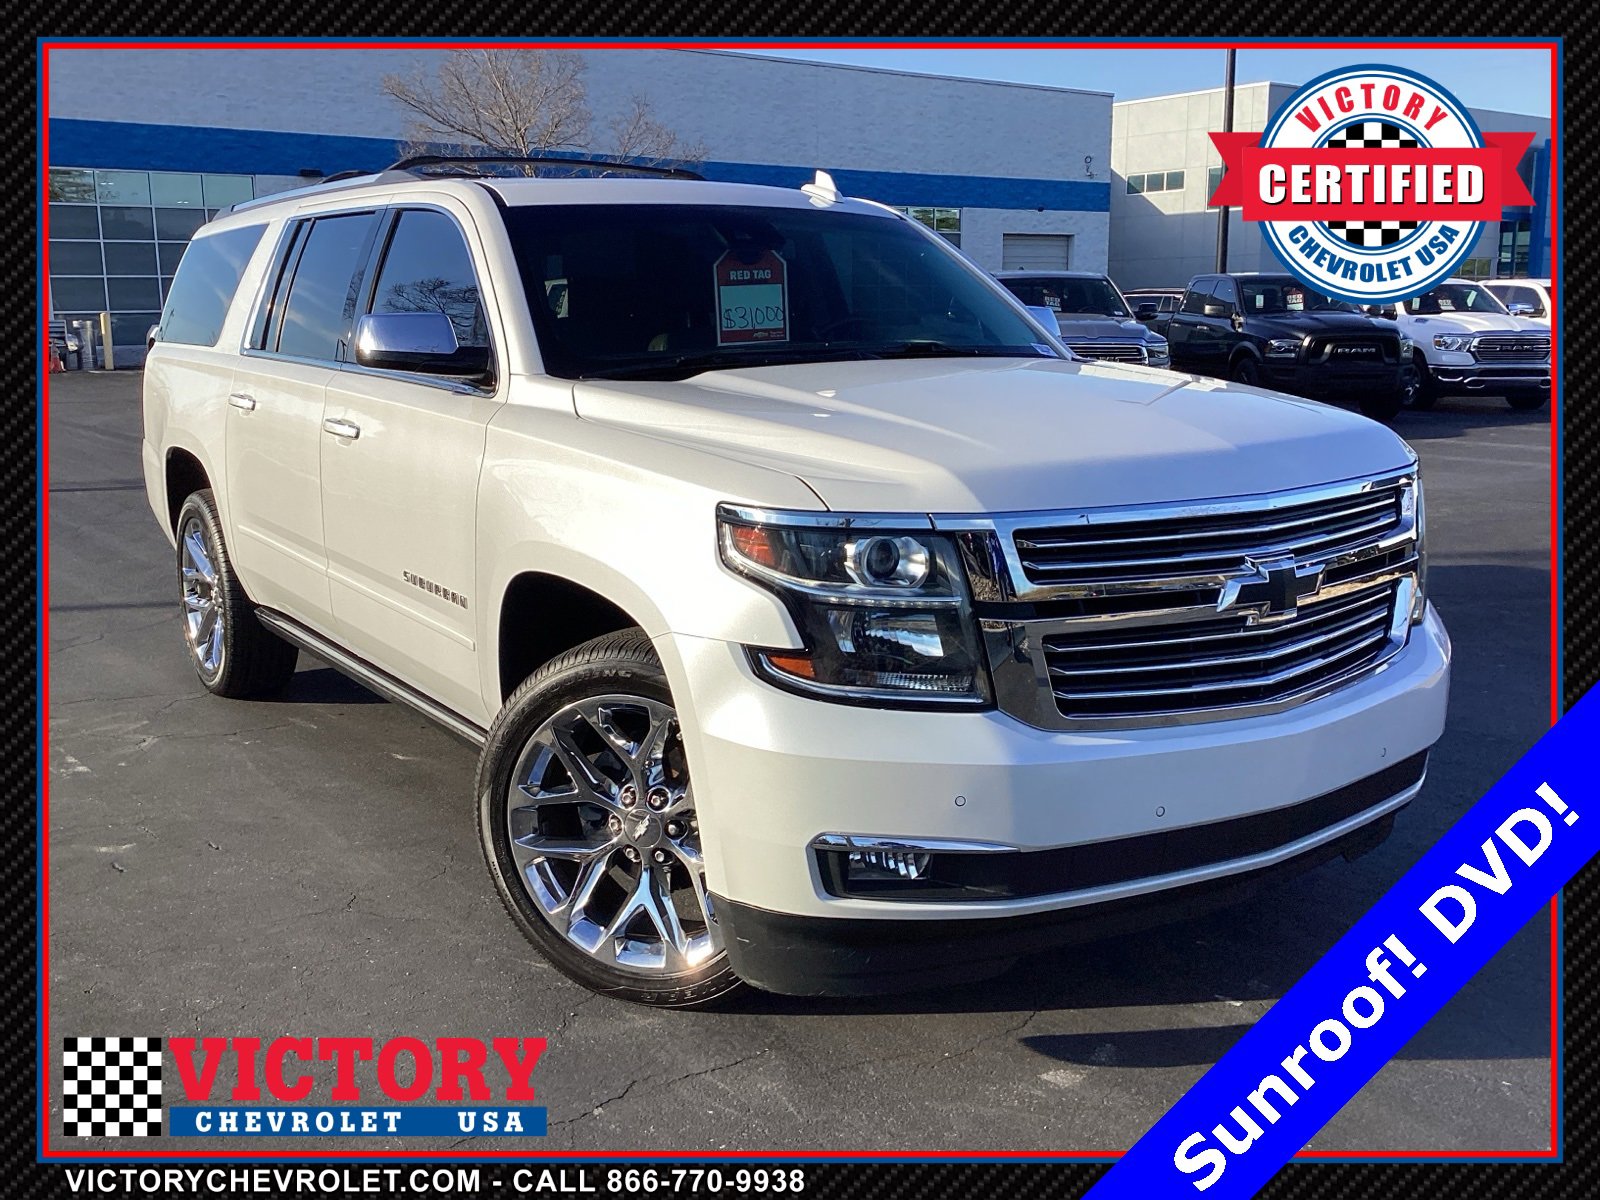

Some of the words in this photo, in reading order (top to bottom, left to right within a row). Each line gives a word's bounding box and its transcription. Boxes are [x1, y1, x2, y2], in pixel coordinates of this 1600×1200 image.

[730, 270, 751, 280] RED
[753, 269, 771, 279] TAG
[403, 569, 469, 610] SUBURBAN
